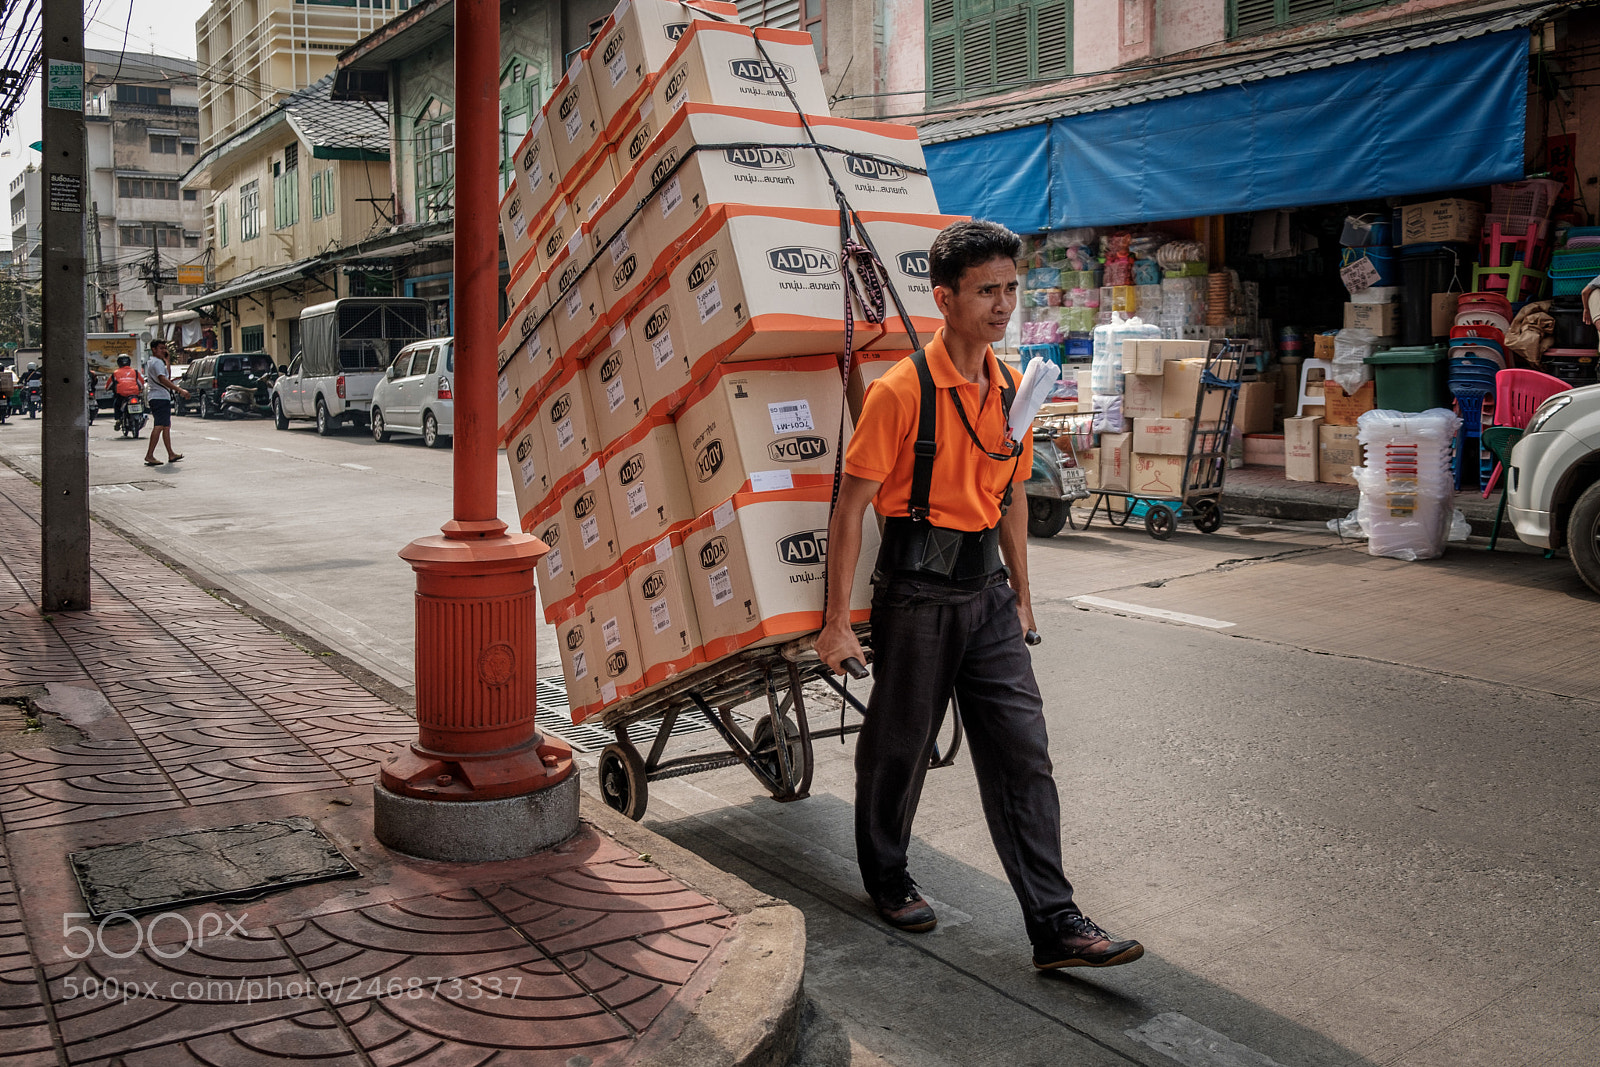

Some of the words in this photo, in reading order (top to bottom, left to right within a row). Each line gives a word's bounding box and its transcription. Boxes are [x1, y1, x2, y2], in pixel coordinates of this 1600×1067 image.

[605, 33, 624, 64] ADDA
[667, 68, 687, 102] ADDA
[561, 90, 578, 119] ADDA
[525, 144, 540, 171] ADDA
[631, 129, 649, 159] ADDA
[733, 148, 787, 164] ADDA
[547, 232, 563, 258] ADDA
[689, 256, 716, 288] ADDA
[777, 252, 832, 270] ADDA
[560, 265, 578, 292] ADDA
[646, 310, 668, 340] ADDA
[602, 355, 621, 382] ADDA
[552, 398, 570, 423] ADDA
[517, 440, 532, 462] ADDA
[698, 442, 722, 477] ADDA
[775, 438, 822, 457] ADDA
[622, 459, 643, 484] ADDA
[575, 496, 595, 518] ADDA
[702, 540, 726, 567] ADDA
[644, 576, 664, 598] ADDA
[568, 629, 583, 648] ADDA
